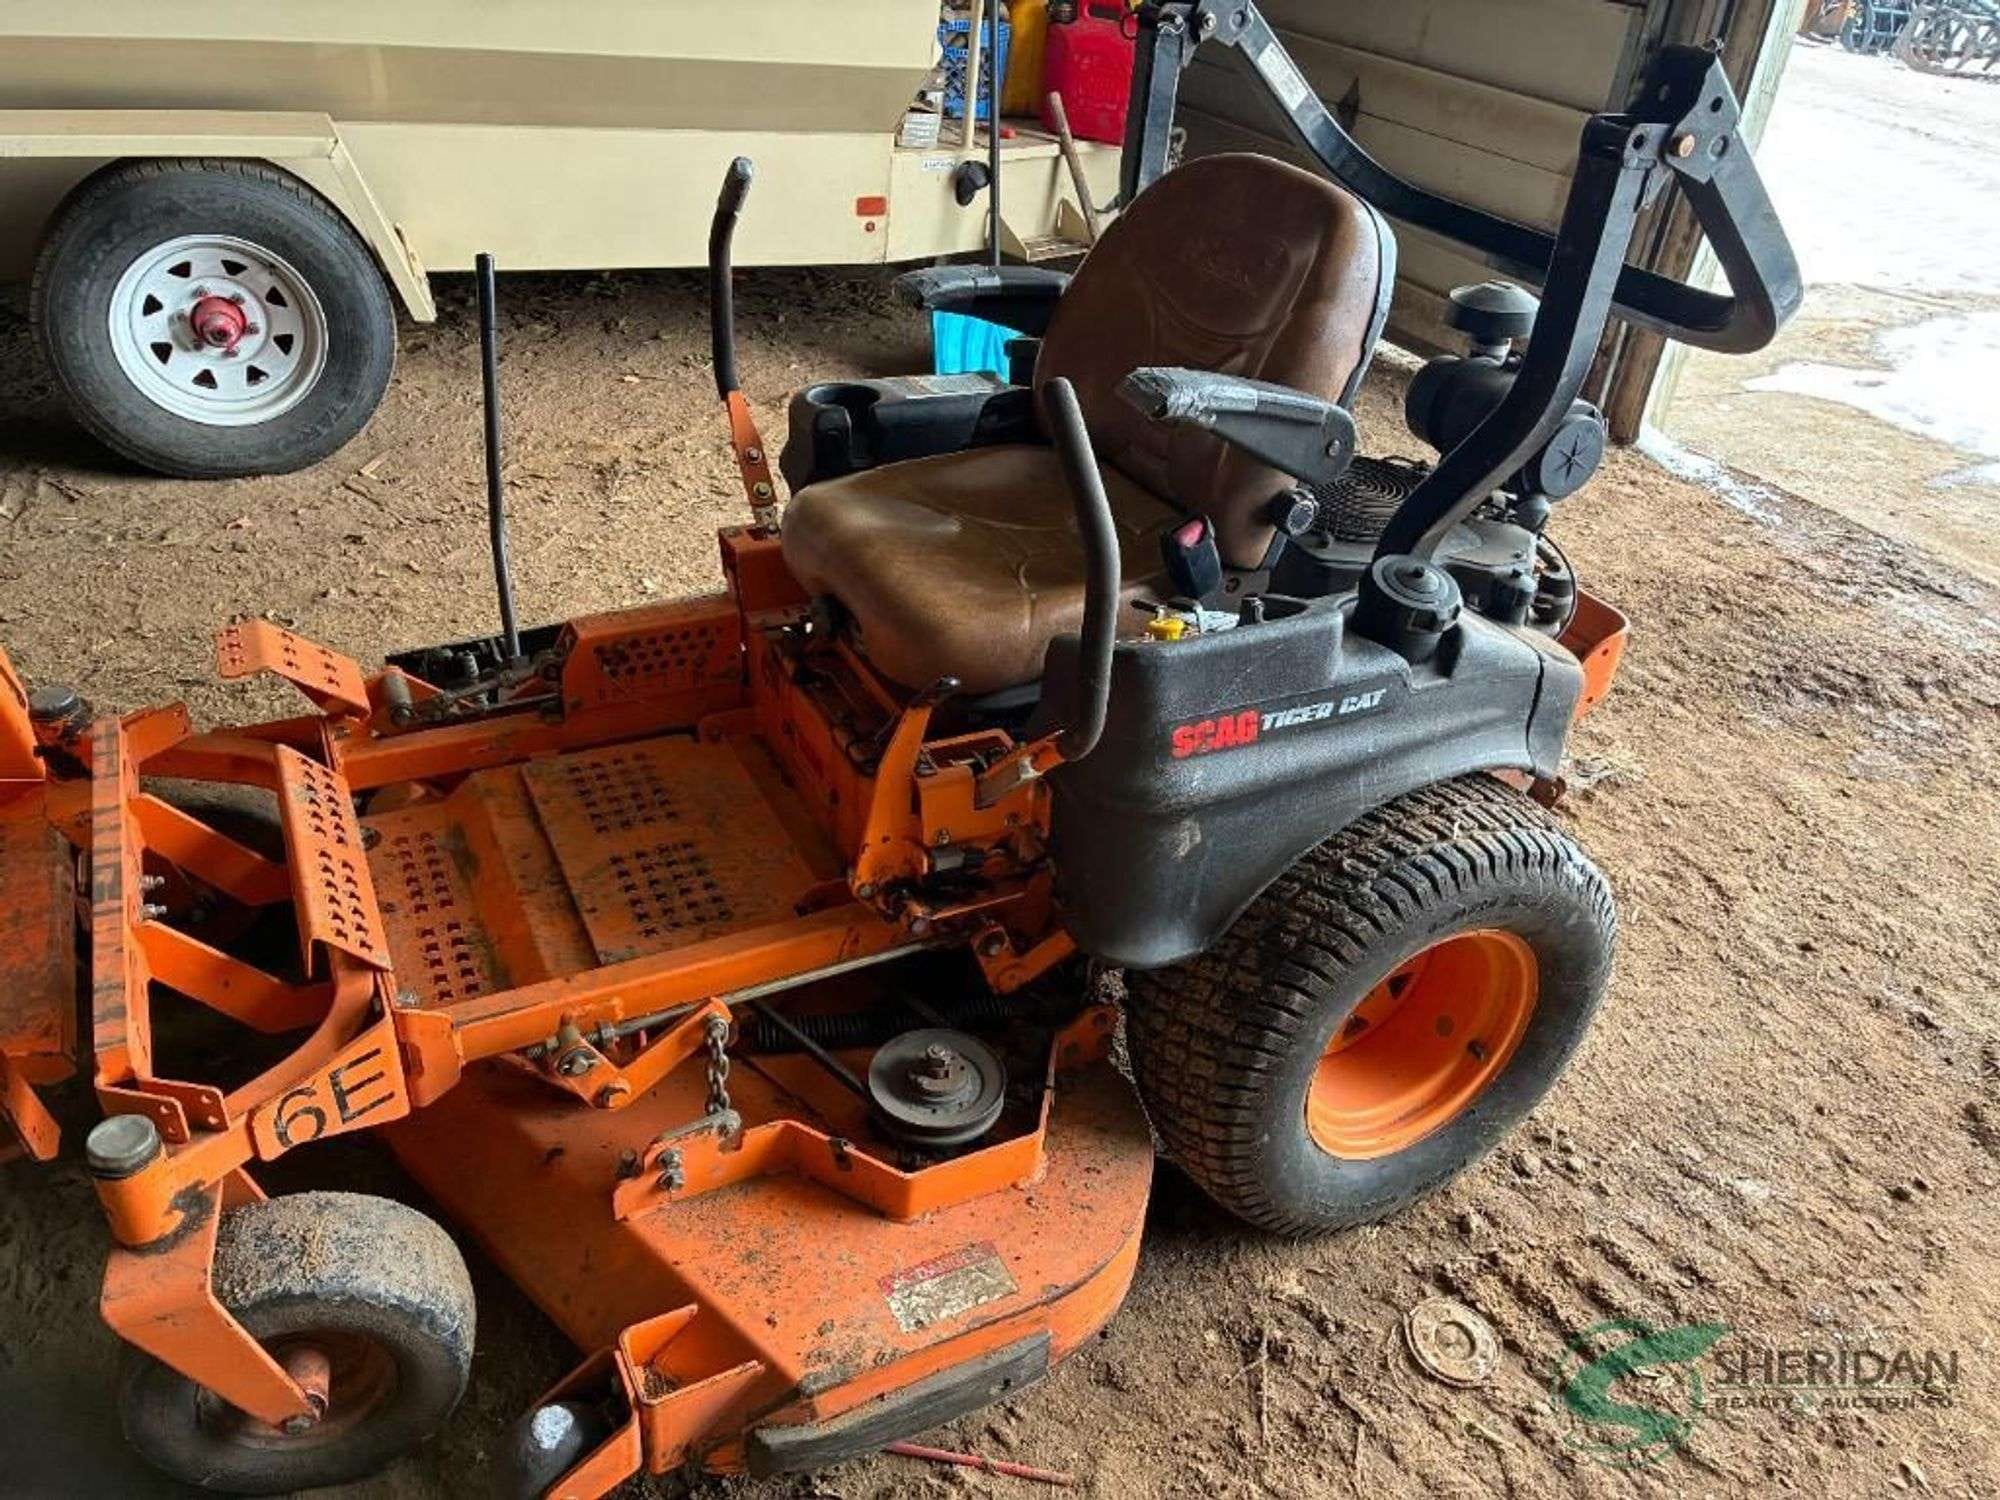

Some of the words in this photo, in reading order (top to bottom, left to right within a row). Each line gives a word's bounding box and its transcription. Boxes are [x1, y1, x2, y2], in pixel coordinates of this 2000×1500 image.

[1171, 708, 1259, 758] SCAG
[1261, 702, 1334, 731] TIGER
[1339, 688, 1387, 714] CAT
[273, 1047, 396, 1148] 6E
